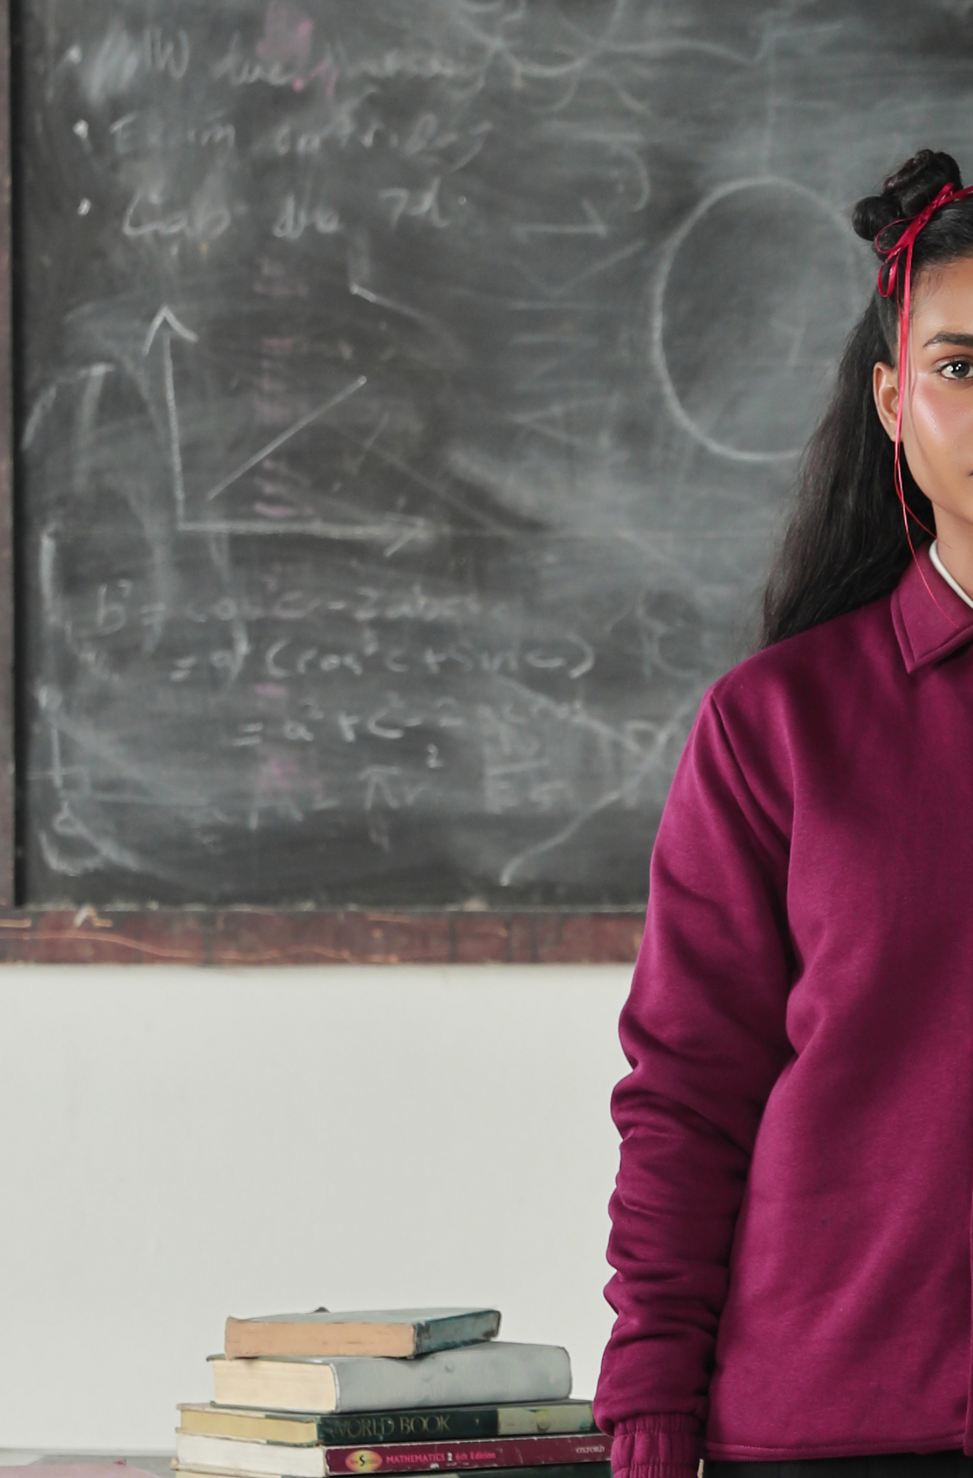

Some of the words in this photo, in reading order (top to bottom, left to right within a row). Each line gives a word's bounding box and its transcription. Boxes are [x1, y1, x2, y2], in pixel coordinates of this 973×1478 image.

[329, 1416, 395, 1438] WORLD
[399, 1415, 451, 1435] BOOK
[386, 1452, 446, 1465] MATHEMATICS
[447, 1451, 453, 1462] 2
[455, 1451, 469, 1461] 6th
[470, 1450, 497, 1461] Edition
[575, 1445, 605, 1454] OXFORD
